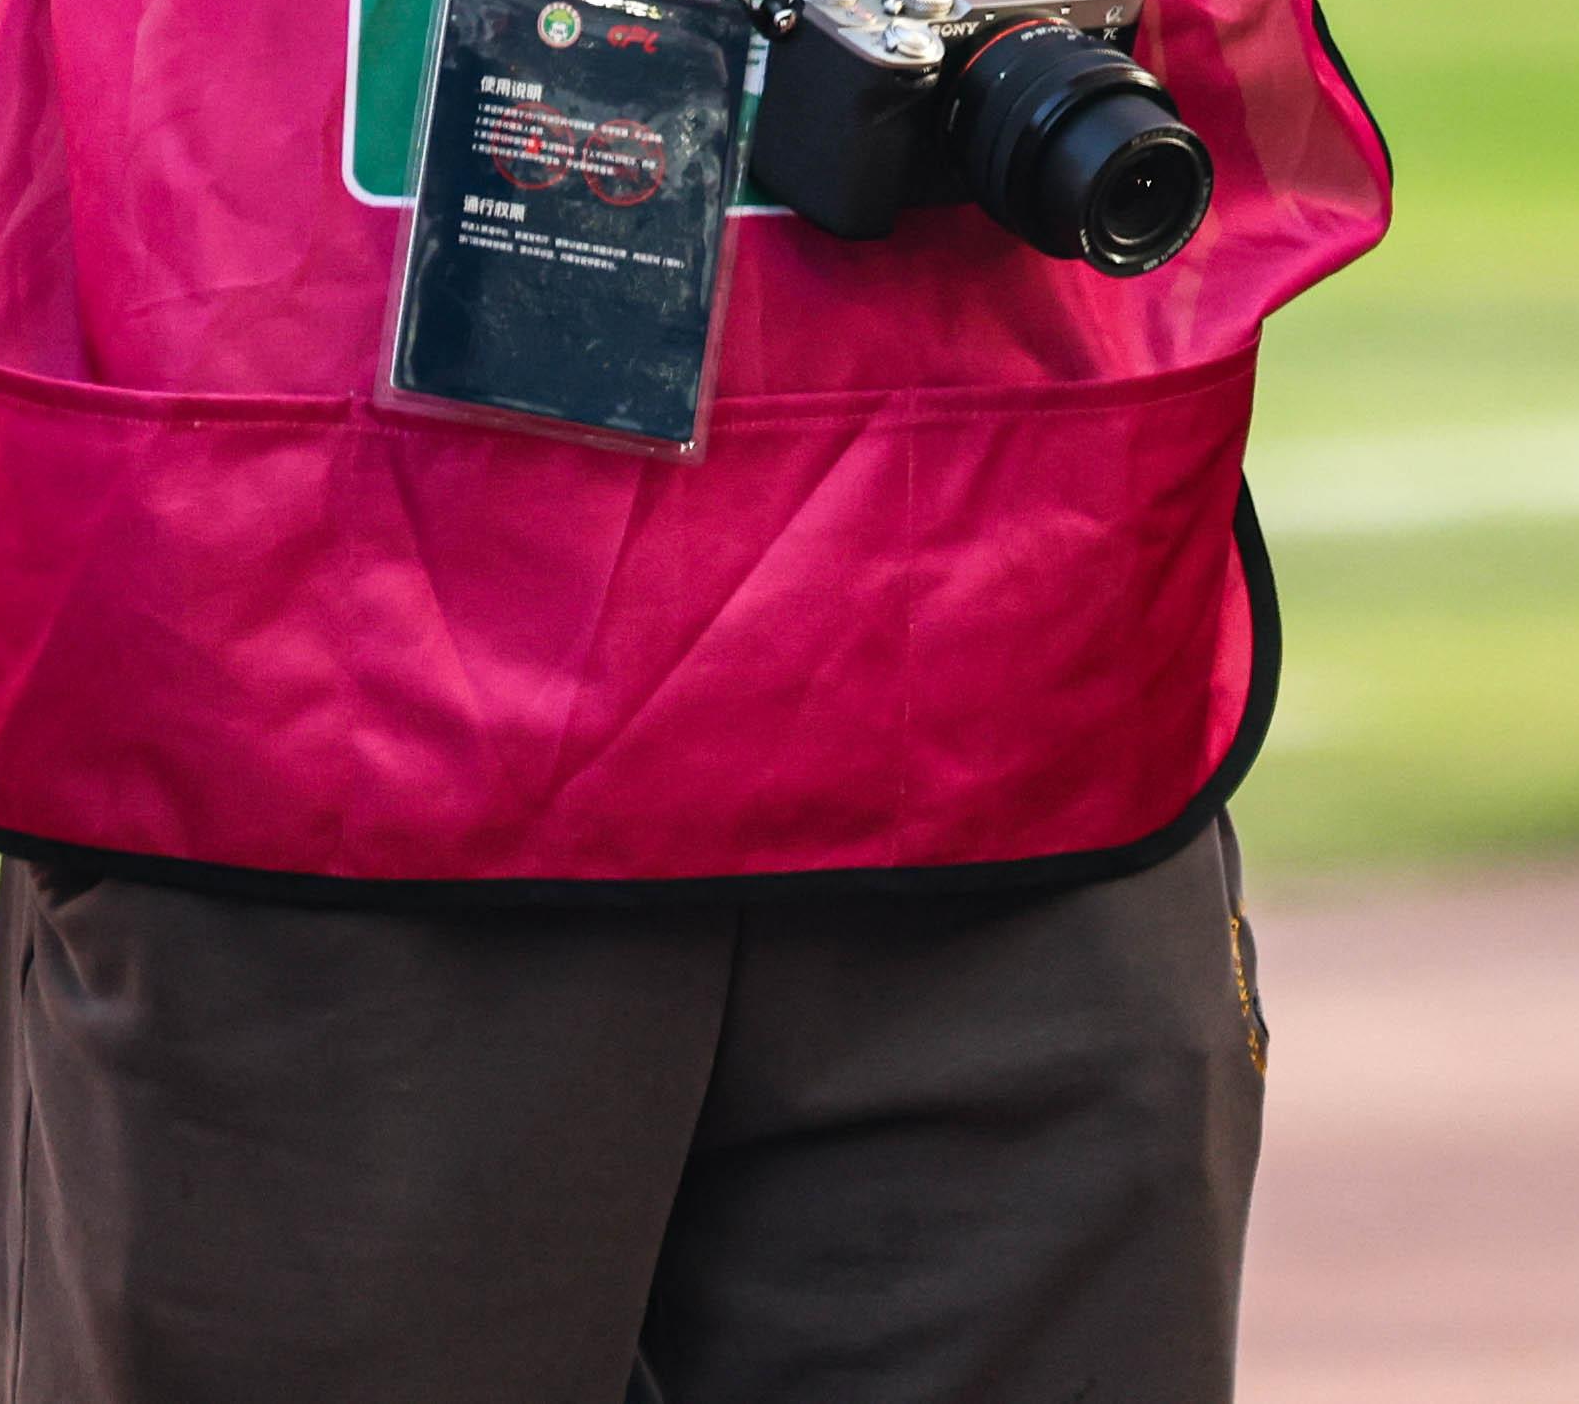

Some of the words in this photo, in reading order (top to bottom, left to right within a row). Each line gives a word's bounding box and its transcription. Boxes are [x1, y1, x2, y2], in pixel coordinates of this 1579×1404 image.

[480, 75, 543, 102] 使用说明
[463, 194, 527, 223] 通行权限
